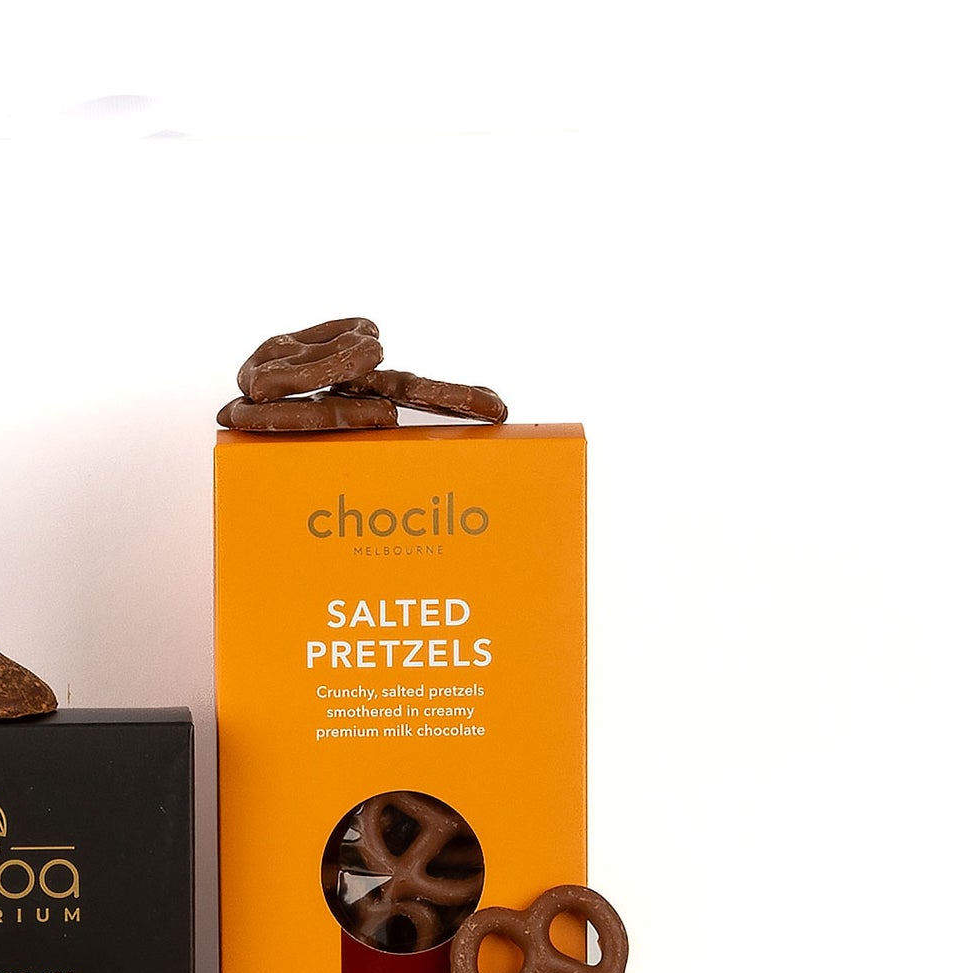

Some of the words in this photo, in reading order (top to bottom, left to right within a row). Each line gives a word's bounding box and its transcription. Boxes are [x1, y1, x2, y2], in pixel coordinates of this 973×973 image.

[307, 492, 490, 539] chocilo
[352, 544, 442, 557] MELBOURNE
[328, 599, 470, 628] SALTED
[307, 639, 491, 668] PRETZELS
[317, 685, 377, 700] Crunchy,
[382, 684, 424, 697] salted
[429, 684, 484, 700] pretzels
[327, 705, 402, 717] smothered
[407, 705, 419, 716] in
[424, 708, 474, 719] creamy
[317, 726, 379, 740] premium
[384, 724, 412, 736] milk
[417, 724, 485, 736] chocolate
